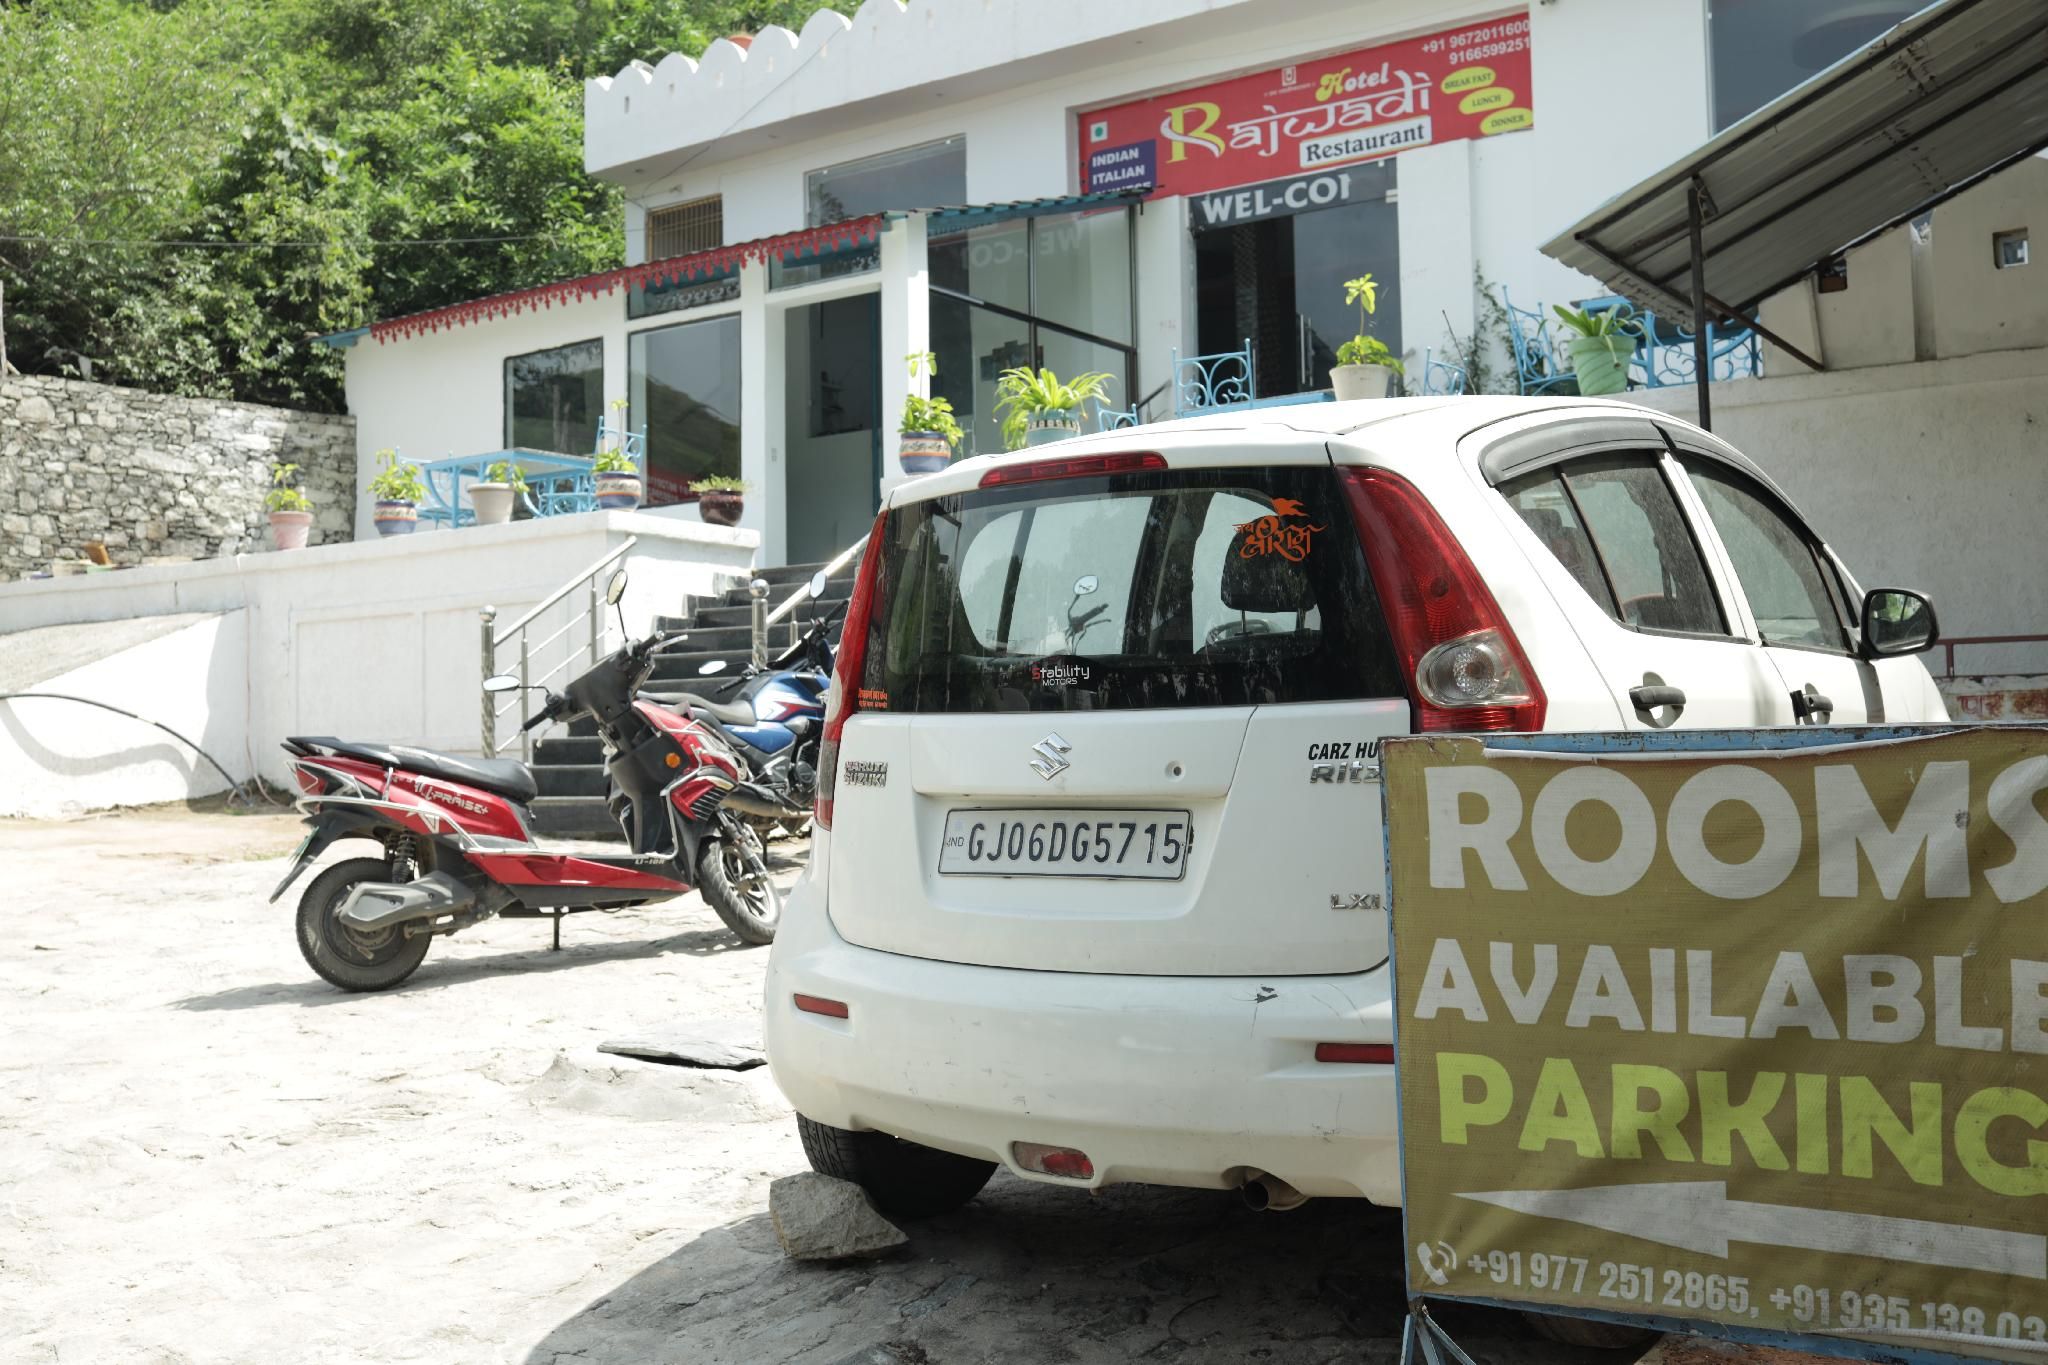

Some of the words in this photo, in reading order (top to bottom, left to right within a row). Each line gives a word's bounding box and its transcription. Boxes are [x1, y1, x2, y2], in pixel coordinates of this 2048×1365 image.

[1422, 38, 1445, 53] +91
[1315, 62, 1389, 102] Hotel
[1472, 94, 1501, 107] LUNCH
[1491, 114, 1524, 128] DINNER
[1305, 123, 1425, 163] Restaurant
[1092, 147, 1139, 168] INDIAN
[1092, 164, 1146, 185] ITALIAN
[1032, 665, 1090, 680] Stability
[1043, 678, 1078, 687] MOTORS
[1308, 743, 1351, 760] CARZ
[845, 761, 888, 773] MARUTI
[844, 771, 887, 788] SUZUKI
[1423, 755, 2048, 903] ROOMS
[968, 822, 1183, 865] GJ06DG5715
[1414, 937, 2048, 1054] AVAILABLE
[1435, 1052, 2048, 1197] PARKING
[1467, 1249, 1521, 1286] +91
[1530, 1252, 1589, 1294] 977
[1598, 1261, 1653, 1303] 251
[1769, 1284, 1830, 1326] +91
[1839, 1290, 1911, 1330] 935
[1921, 1302, 1985, 1336] 138
